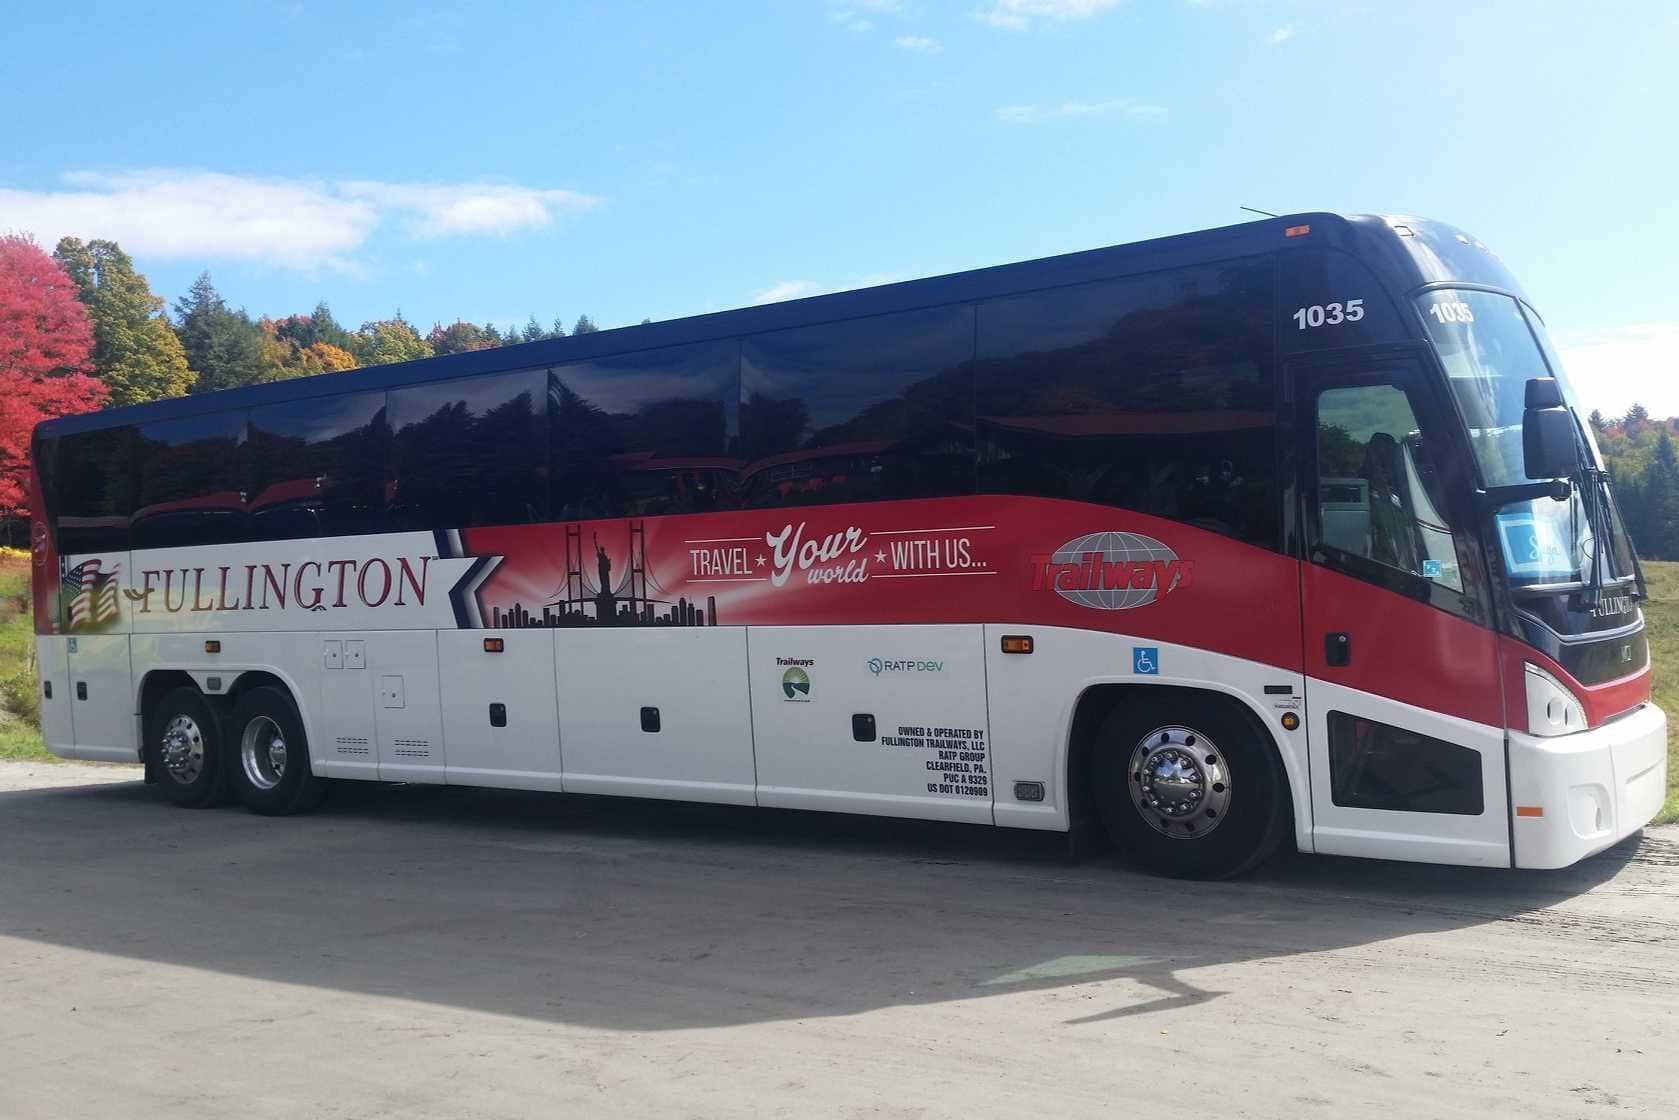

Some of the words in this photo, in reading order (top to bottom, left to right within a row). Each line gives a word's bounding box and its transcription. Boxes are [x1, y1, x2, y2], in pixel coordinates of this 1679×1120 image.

[1293, 299, 1365, 330] 1035
[1430, 302, 1474, 324] 1035
[690, 548, 752, 576] TRAVEL
[766, 522, 867, 587] Your
[890, 539, 939, 570] WITH
[945, 538, 987, 568] US...
[807, 558, 868, 584] world
[1031, 552, 1195, 601] Trailways
[123, 556, 431, 613] FULLINGTON
[776, 657, 814, 667] Trailways
[881, 736, 925, 748] FULLINGTON
[971, 741, 985, 751] LLC
[898, 726, 925, 737] OWNED
[926, 728, 933, 737] &
[934, 728, 972, 739] OPERATED
[974, 729, 984, 740] BY
[938, 750, 958, 761] RATP
[959, 752, 986, 762] GROUP
[943, 772, 960, 783] PUC
[961, 774, 967, 784] A
[973, 763, 987, 774] PA.
[927, 783, 938, 793] US
[939, 783, 954, 794] DOT
